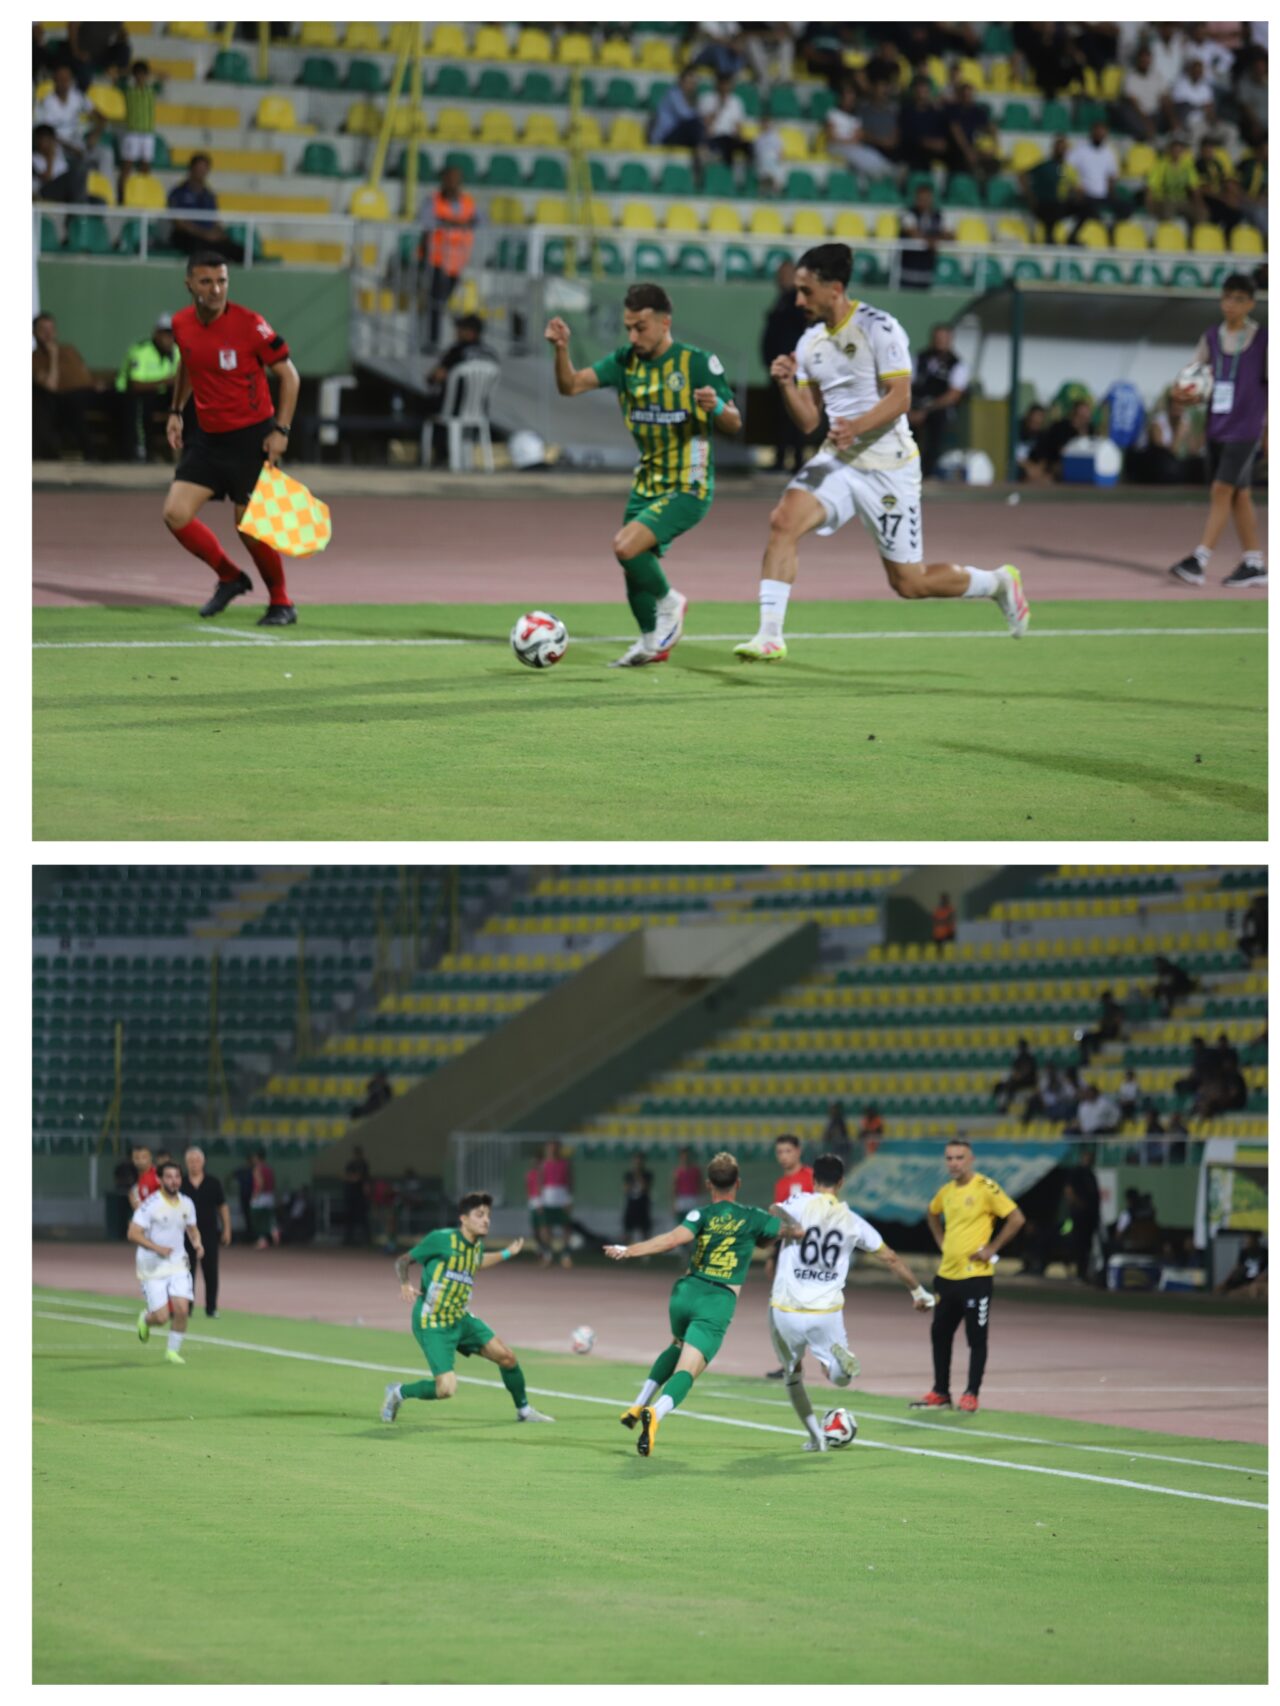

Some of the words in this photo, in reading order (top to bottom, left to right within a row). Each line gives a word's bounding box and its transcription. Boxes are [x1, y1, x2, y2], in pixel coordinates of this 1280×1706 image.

[877, 513, 903, 537] 17
[694, 1233, 739, 1270] 14
[800, 1226, 843, 1269] 66
